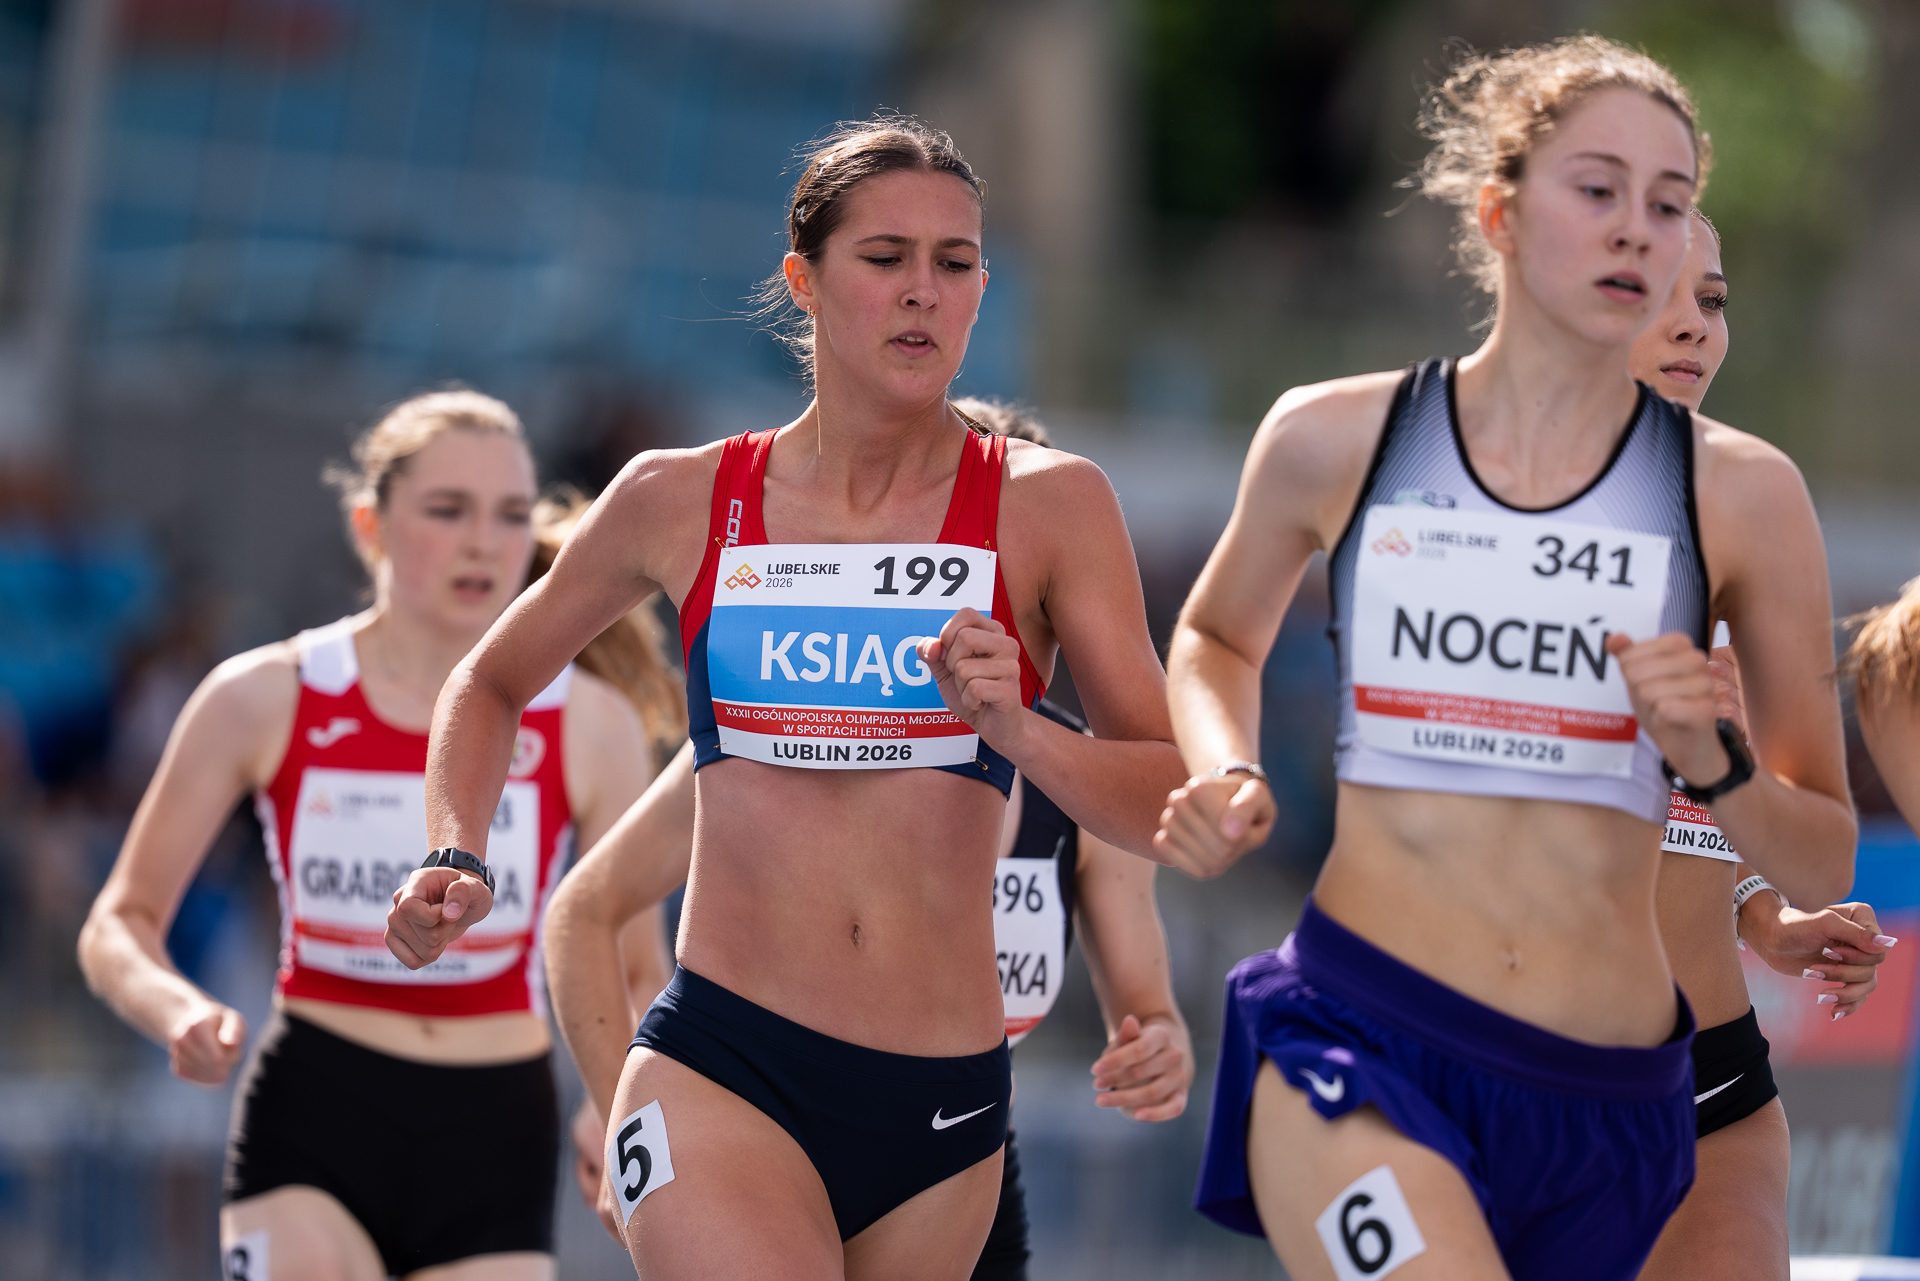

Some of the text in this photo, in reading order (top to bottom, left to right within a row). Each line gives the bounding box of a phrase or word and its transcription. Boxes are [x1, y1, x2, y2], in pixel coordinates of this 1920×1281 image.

[767, 562, 841, 575] LUBELSKIE
[873, 556, 970, 597] 199
[1531, 535, 1635, 588] 341
[765, 577, 793, 588] 2026
[760, 631, 931, 697] KSIĄG
[1390, 606, 1611, 682] NOCEŃ
[725, 706, 965, 725] XXXII OGÓLNOPOLSKA OLIMPIADA MŁODZIE
[783, 724, 906, 737] W SPORTACH LETNICH
[773, 742, 912, 762] LUBLIN 2026
[1413, 728, 1565, 764] LUBLIN 2026
[301, 857, 523, 908] GRABA
[617, 1116, 652, 1202] 5
[1341, 1193, 1392, 1274] 6
